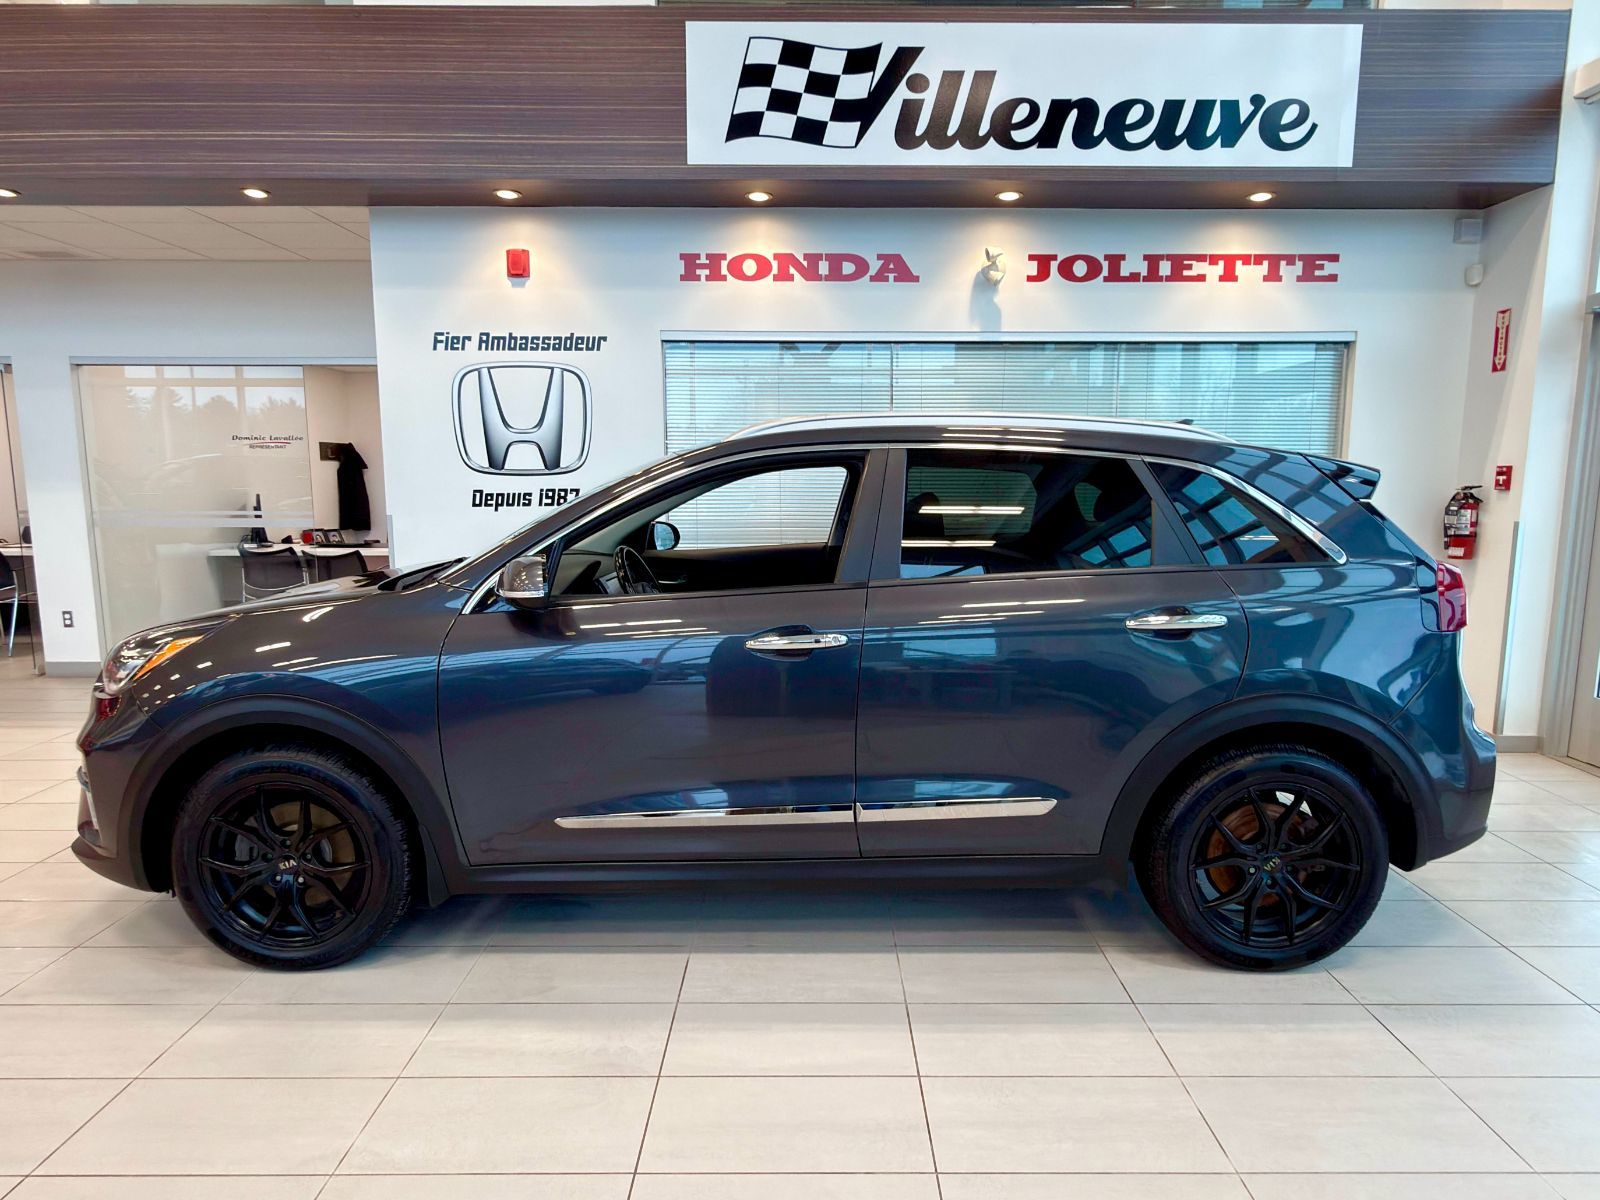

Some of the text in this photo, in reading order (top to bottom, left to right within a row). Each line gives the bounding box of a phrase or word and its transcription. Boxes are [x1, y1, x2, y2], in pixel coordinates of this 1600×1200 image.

[725, 36, 1319, 152] Villeneuve
[680, 252, 1339, 283] HONDA JOLIETTE
[432, 332, 608, 351] Fier Ambassadeur
[471, 489, 533, 512] Depuis
[278, 859, 297, 870] KIA
